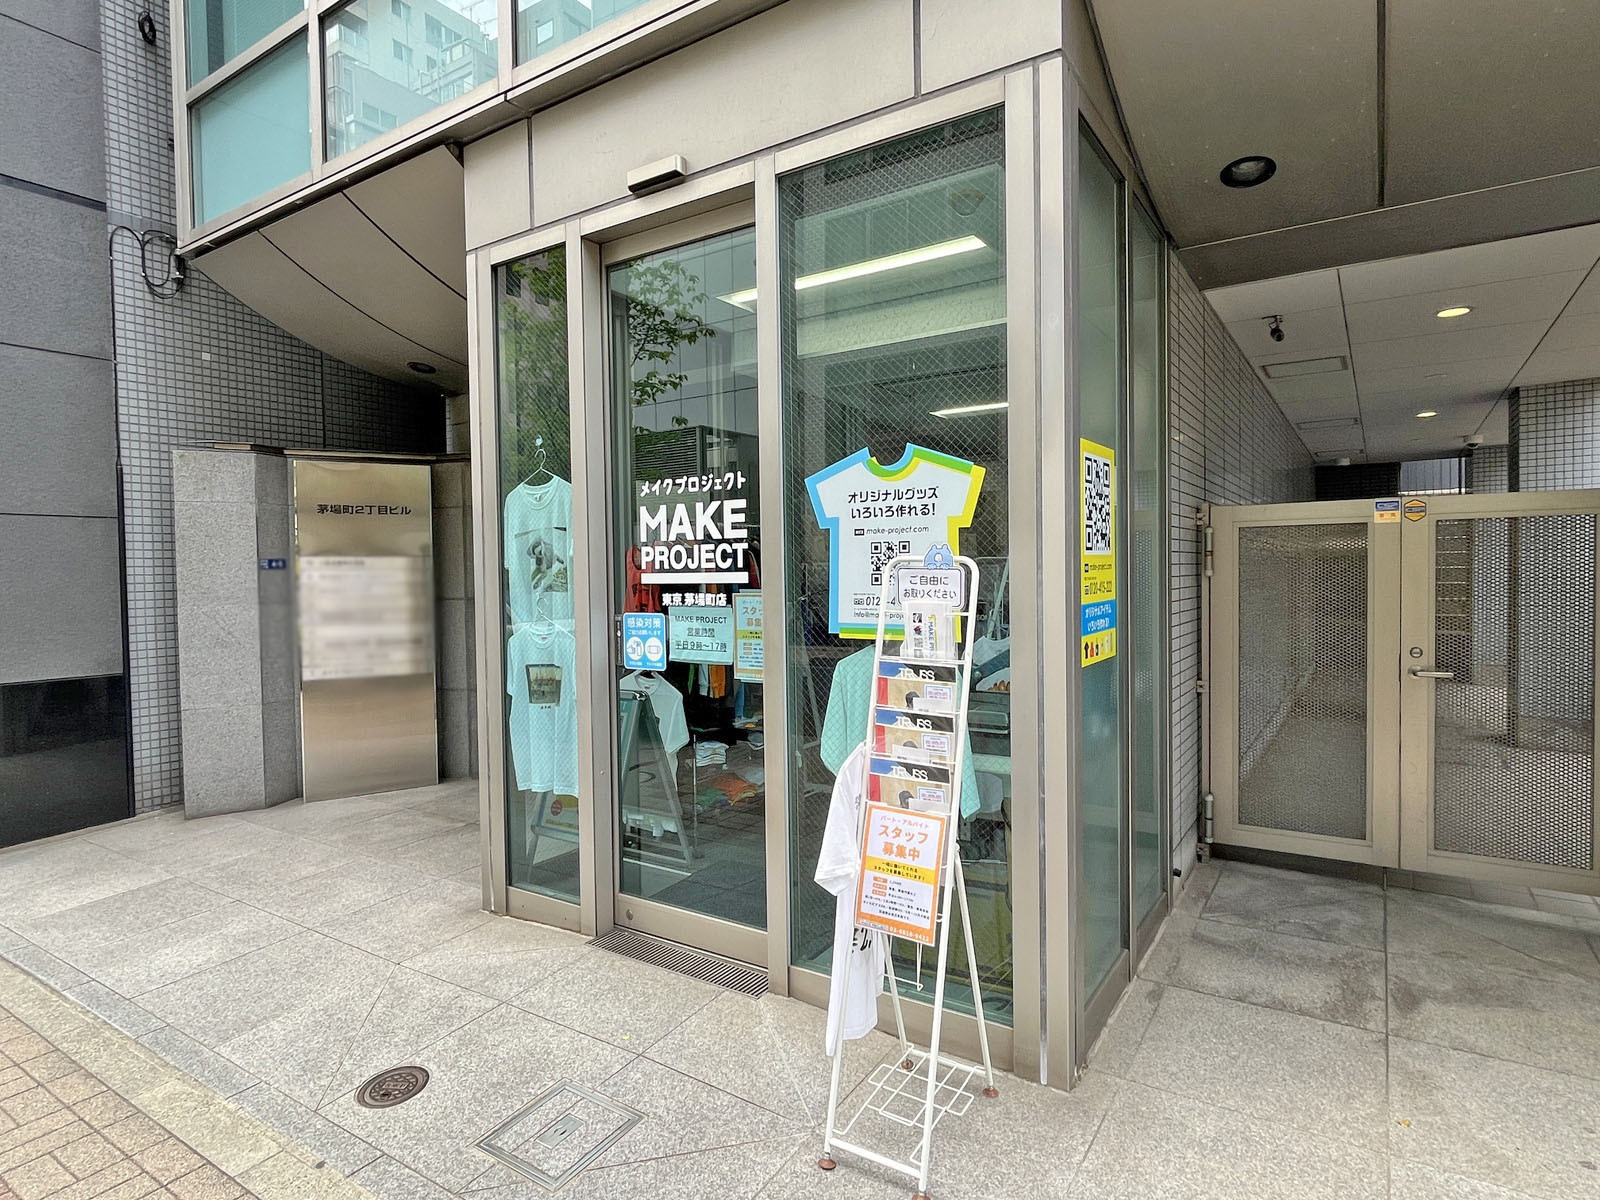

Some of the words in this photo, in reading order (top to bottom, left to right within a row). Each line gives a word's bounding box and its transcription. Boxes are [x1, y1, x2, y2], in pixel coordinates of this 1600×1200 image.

[640, 470, 747, 497] メイクプロジェクト
[848, 486, 939, 503] オリジナルグッズ
[316, 503, 412, 516] 茅場町2丁目ビル
[851, 503, 936, 519] いろいろ作れる!
[640, 498, 748, 543] MAKE
[866, 526, 930, 536] make-project.com
[641, 542, 749, 570] PROJECT
[909, 575, 950, 586] ご自由に
[662, 593, 682, 607] 東京
[684, 593, 728, 607] 茅場町店
[903, 588, 957, 599] お取りください
[675, 615, 694, 623] MAKE
[695, 616, 728, 624] PROJECT
[687, 627, 716, 637] 営業時間
[878, 824, 929, 845] スタッフ
[881, 841, 921, 861] 募集中
